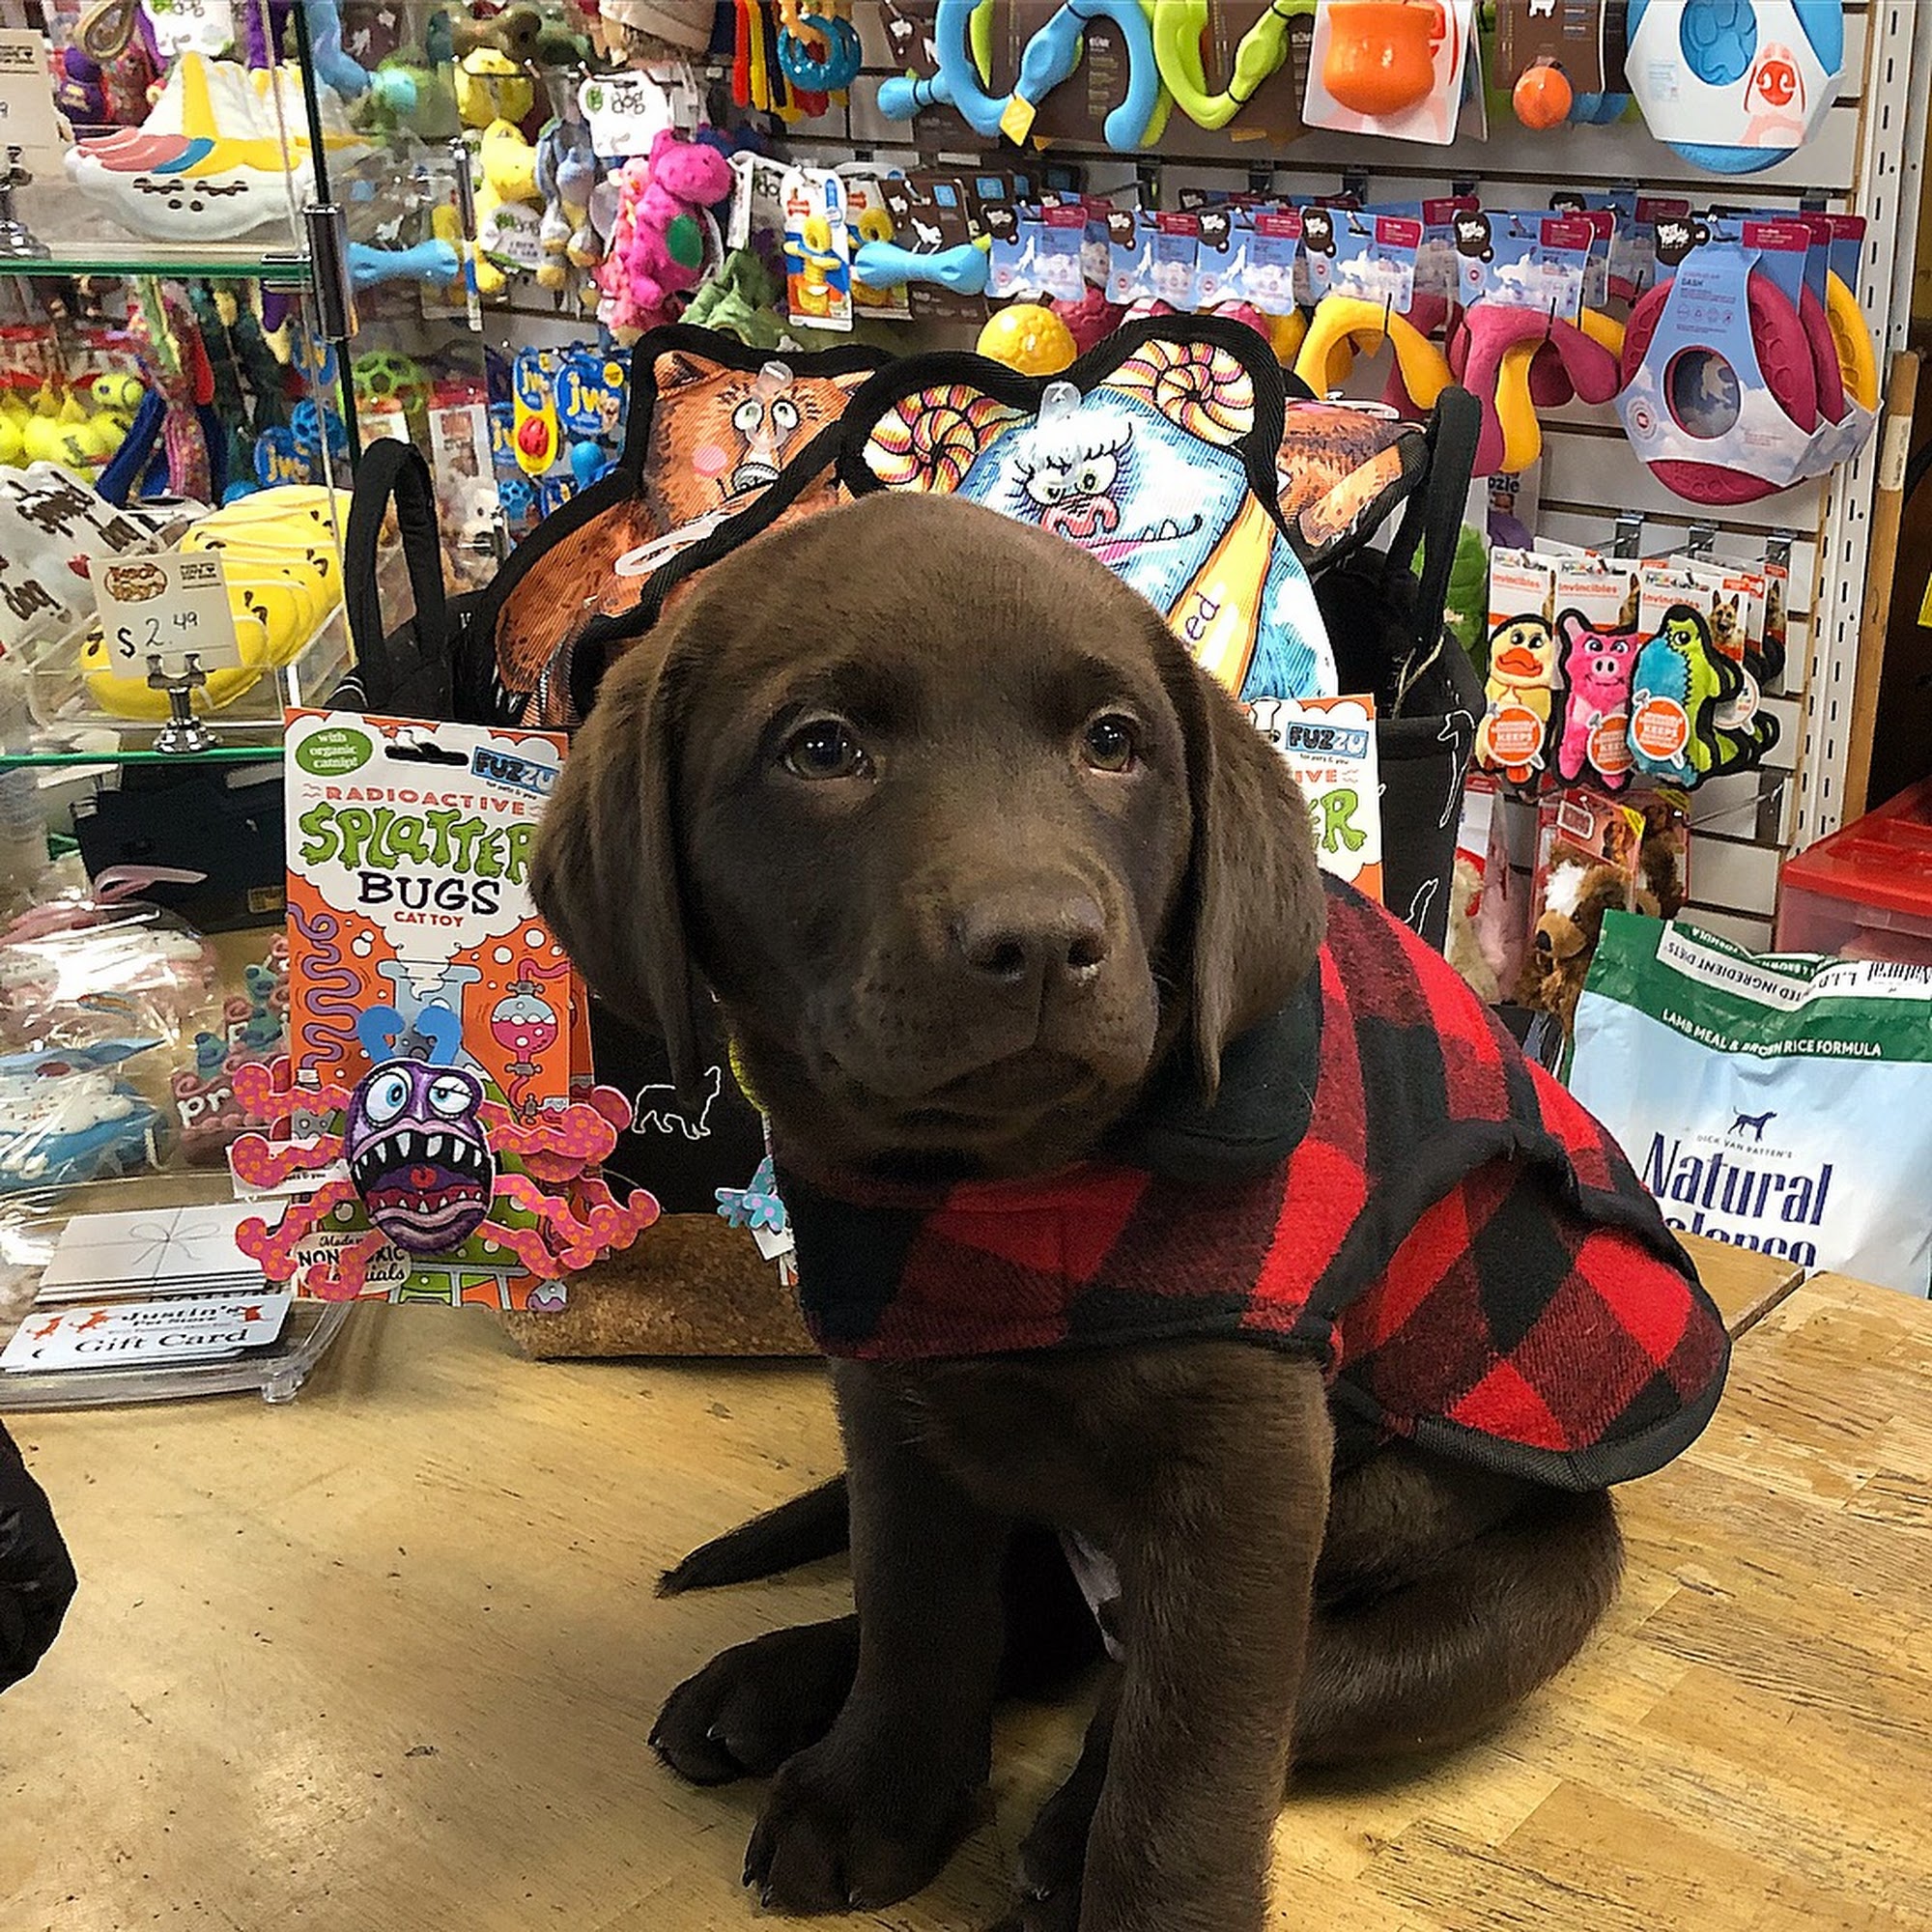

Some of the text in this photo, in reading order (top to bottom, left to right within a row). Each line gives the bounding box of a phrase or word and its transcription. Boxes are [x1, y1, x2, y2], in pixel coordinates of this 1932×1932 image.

[1185, 591, 1221, 640] ed
[117, 626, 137, 659] $
[317, 731, 348, 743] with
[1290, 725, 1366, 755] FUZZU
[309, 745, 357, 757] organic
[1294, 769, 1338, 783] IVE
[326, 786, 526, 816] RADIOACTIVE
[357, 871, 500, 916] BUGS
[394, 911, 465, 928] CAT TOY
[1667, 942, 1804, 1003] TED INGREDIENT DIETS
[1662, 1008, 1692, 1033] LAMB
[1693, 1025, 1727, 1049] MEAL
[1741, 1040, 1782, 1057] BROWN
[1783, 1039, 1814, 1053] RICE
[1816, 1040, 1883, 1057] FORMULA
[1697, 1134, 1719, 1144] DICK
[1724, 1139, 1744, 1151] VAN
[1642, 1131, 1834, 1226] Natural
[319, 1236, 355, 1247] Made
[121, 1305, 240, 1321] Justin's
[74, 1336, 149, 1352] Gift
[158, 1328, 248, 1349] Card
